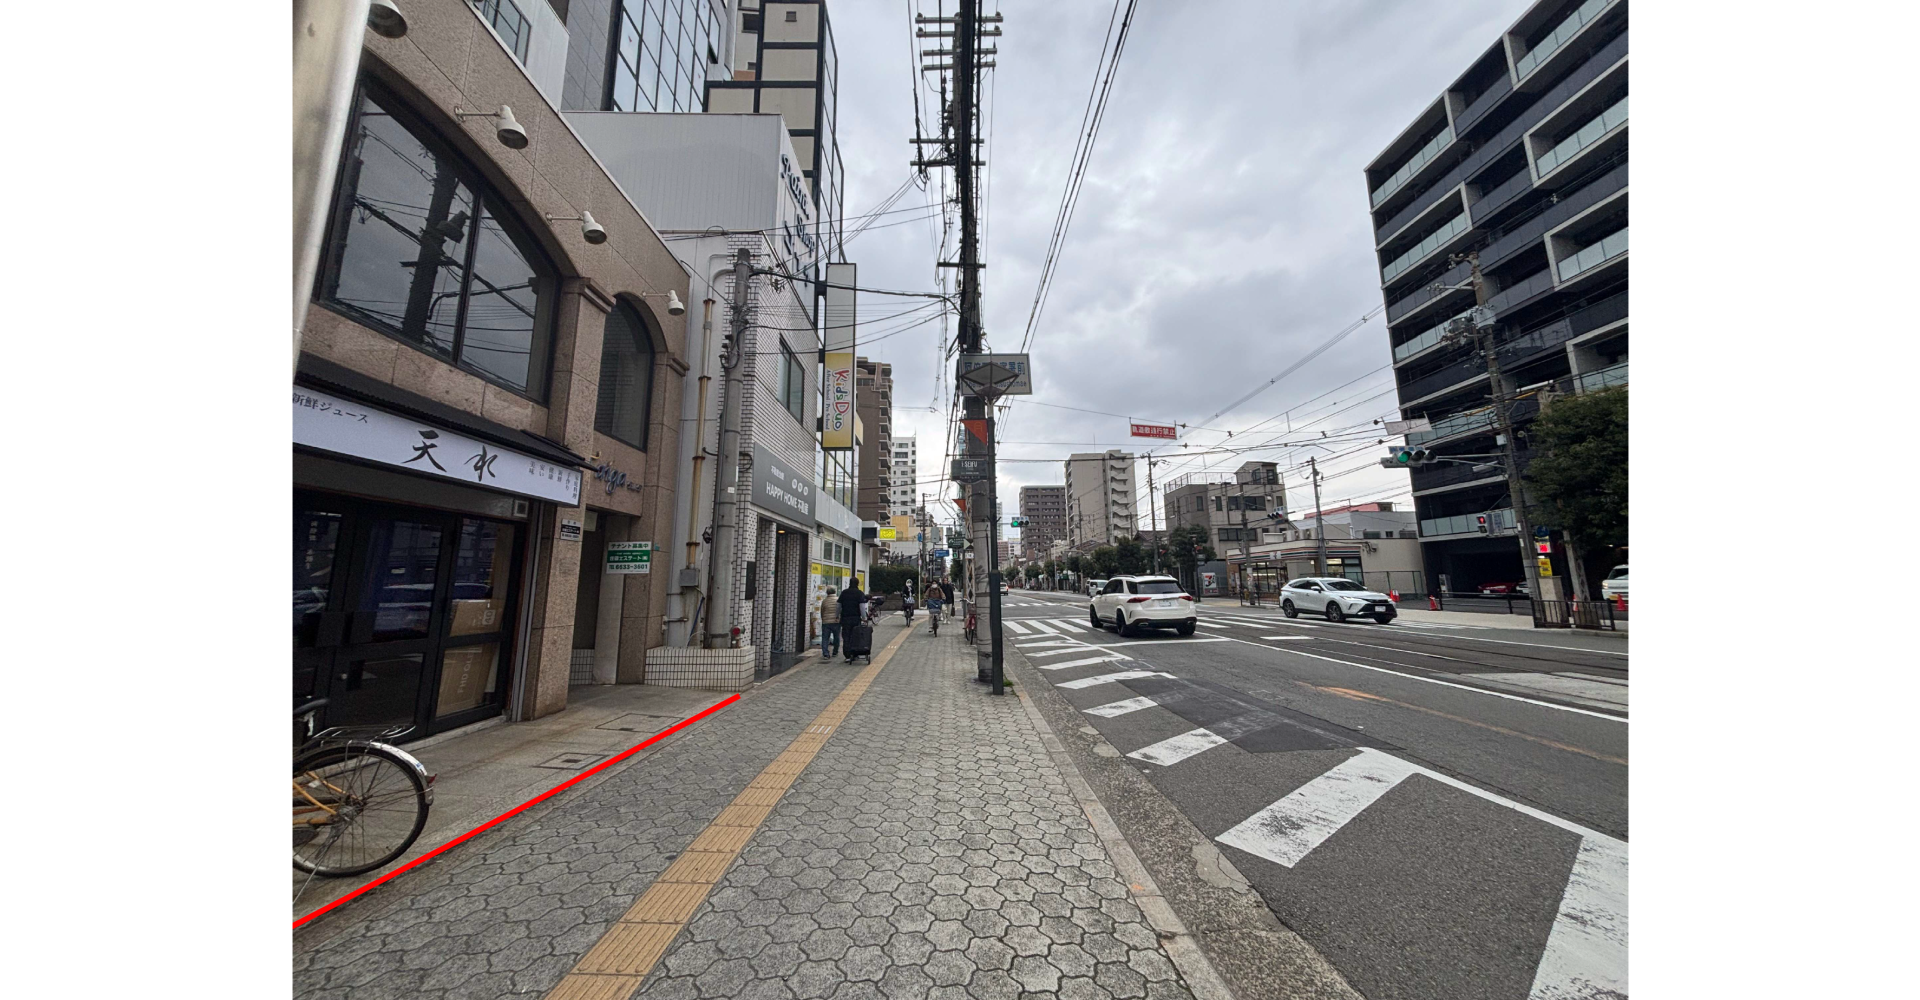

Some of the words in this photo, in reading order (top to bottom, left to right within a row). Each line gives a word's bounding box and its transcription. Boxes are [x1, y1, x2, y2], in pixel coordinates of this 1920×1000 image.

[293, 394, 369, 424] 新鮮ジュース
[834, 369, 850, 430] KidsDuo
[765, 481, 784, 501] HAPPY
[783, 491, 798, 509] HOME
[797, 498, 809, 516] 不動産
